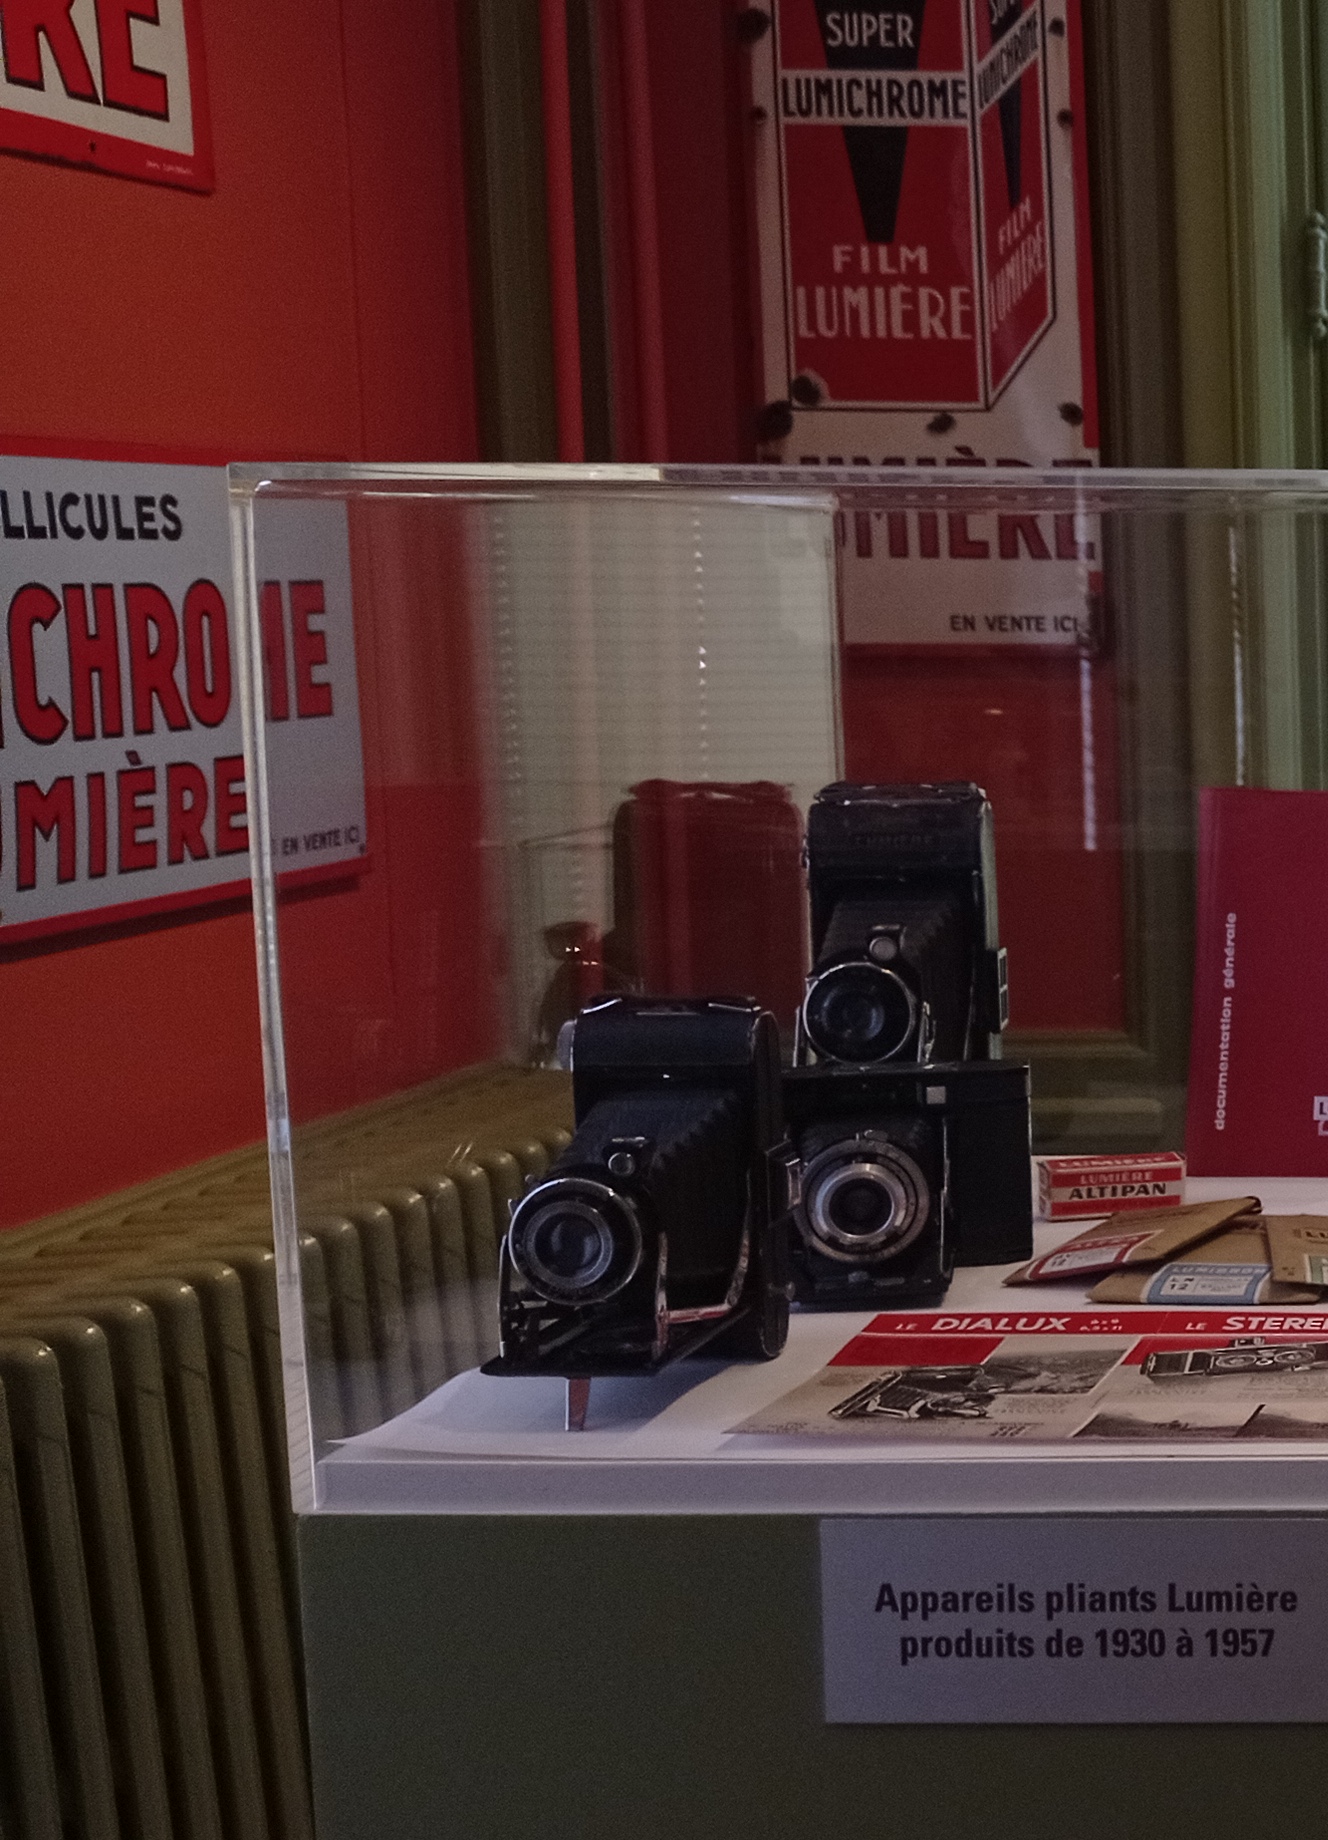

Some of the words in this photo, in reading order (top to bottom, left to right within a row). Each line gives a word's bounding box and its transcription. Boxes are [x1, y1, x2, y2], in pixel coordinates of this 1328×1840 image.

[826, 12, 915, 48] SUPER
[781, 77, 969, 120] LUMICHROME
[833, 244, 929, 275] FILM
[797, 283, 974, 340] LUMIÈRE
[950, 615, 975, 633] EN
[984, 615, 1046, 633] VENTE
[1053, 615, 1078, 632] ICI
[1223, 912, 1237, 989] générale
[1215, 996, 1233, 1130] documentation
[1069, 1183, 1166, 1200] ALTIPAN
[931, 1317, 1071, 1332] DIALUX
[875, 1583, 1035, 1621] Appareils
[1046, 1583, 1157, 1621] pliants
[1168, 1583, 1299, 1613] Lumière
[900, 1628, 1035, 1666] produits
[1045, 1628, 1085, 1658] de
[1096, 1628, 1166, 1658] 1930
[1176, 1628, 1194, 1658] à
[1205, 1628, 1275, 1658] 1957
